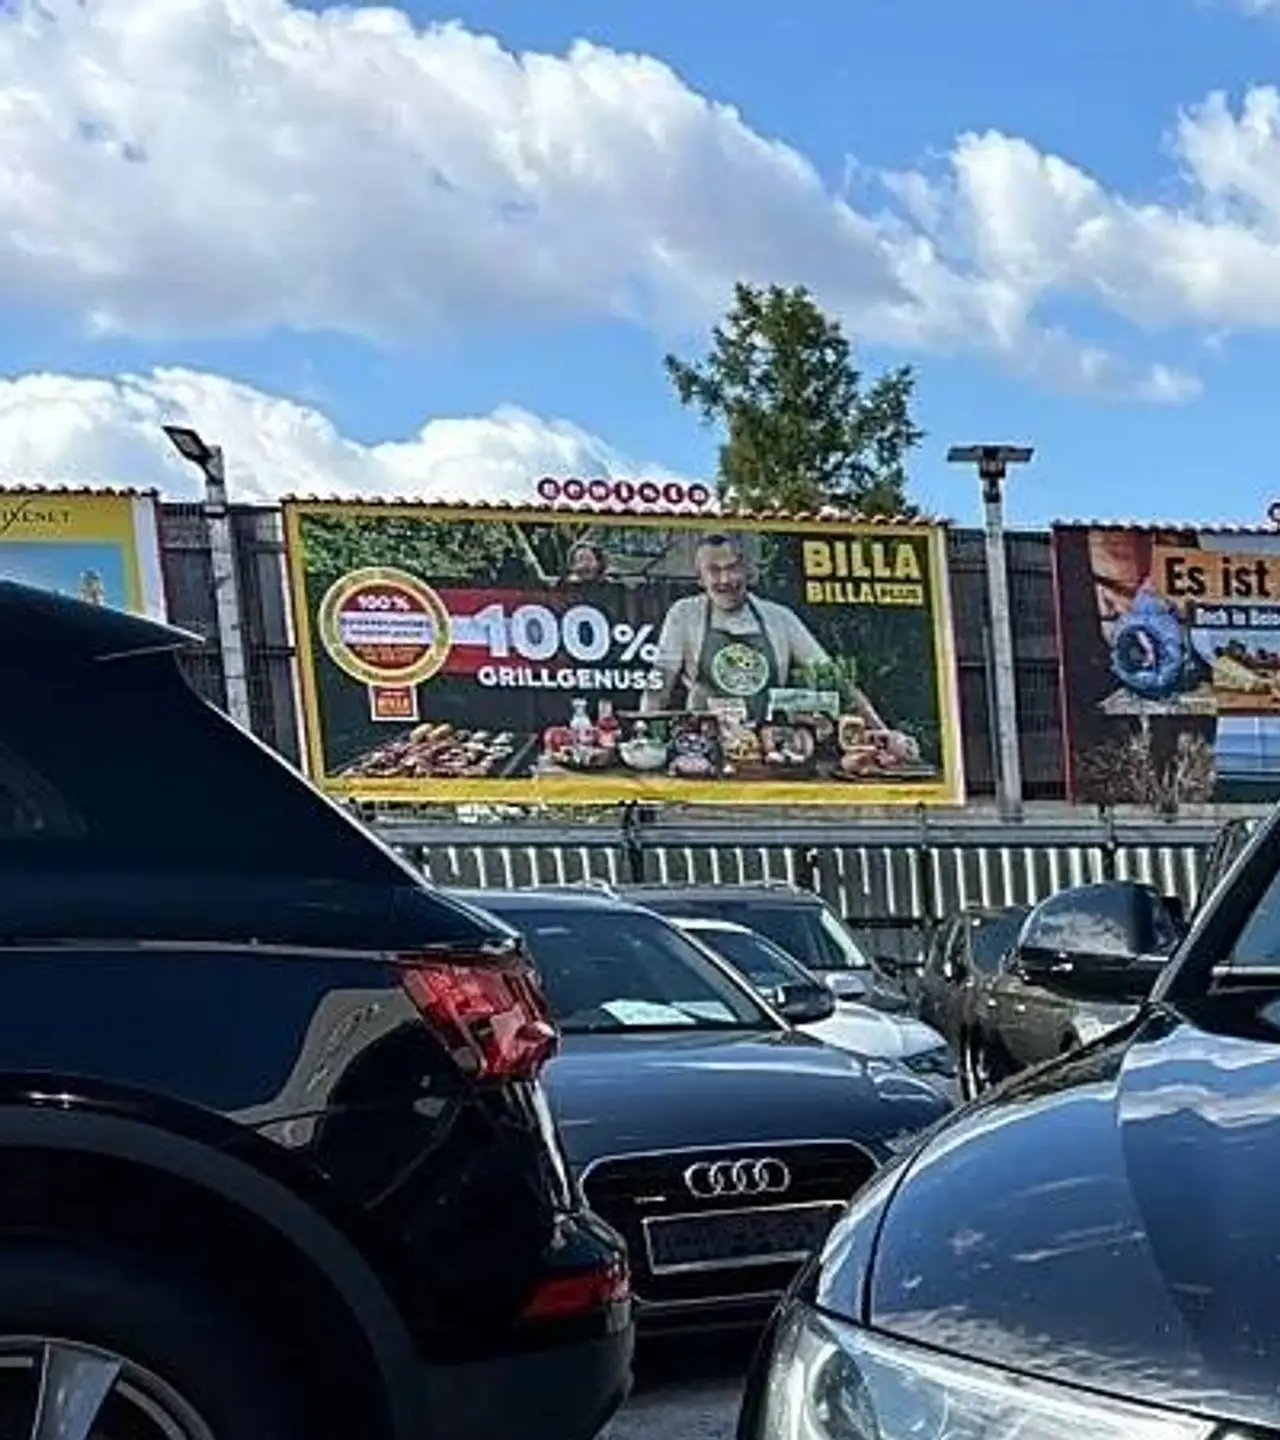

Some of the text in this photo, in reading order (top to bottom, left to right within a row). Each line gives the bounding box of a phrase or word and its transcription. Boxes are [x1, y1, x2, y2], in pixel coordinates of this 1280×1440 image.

[803, 540, 921, 579] BILLA
[1165, 556, 1206, 597] Es
[1222, 556, 1270, 598] ist
[806, 580, 875, 604] BILLA
[474, 604, 661, 662] 100%
[478, 665, 665, 690] GRILLGENUSS
